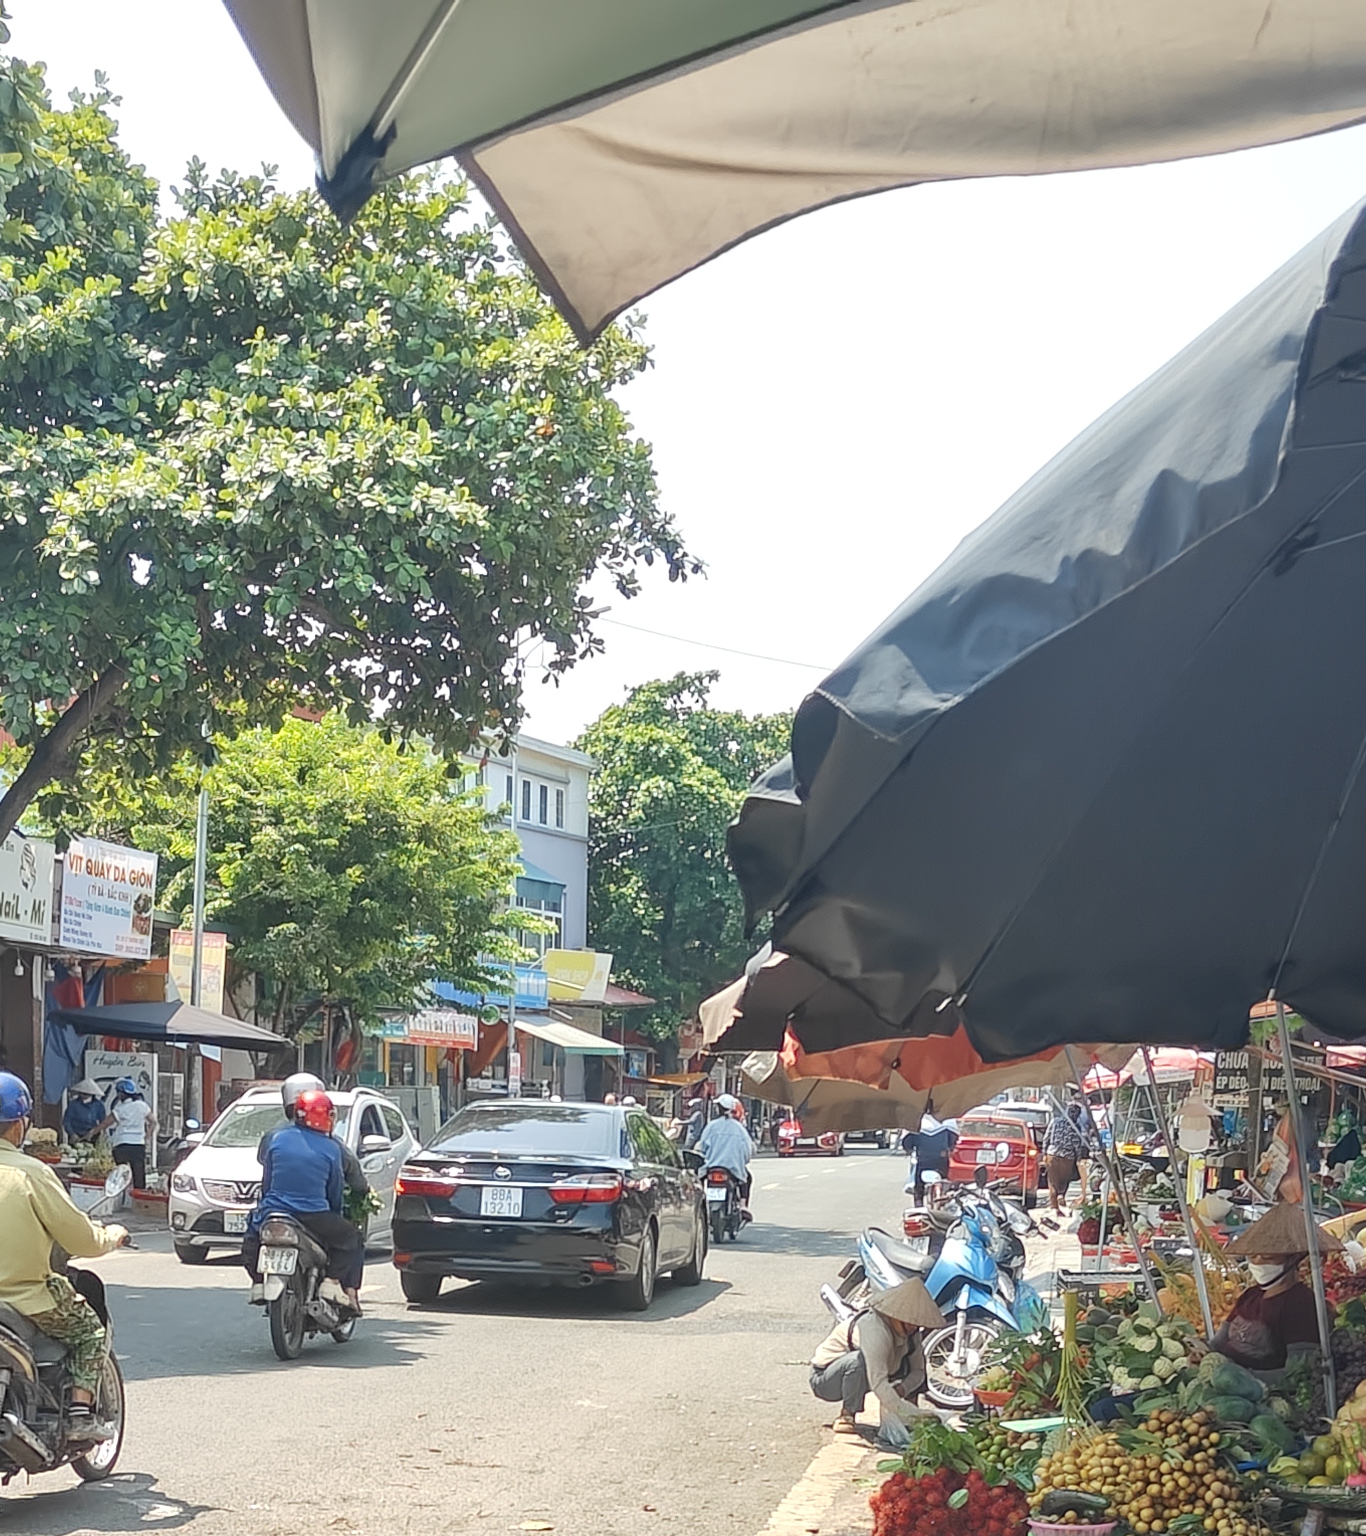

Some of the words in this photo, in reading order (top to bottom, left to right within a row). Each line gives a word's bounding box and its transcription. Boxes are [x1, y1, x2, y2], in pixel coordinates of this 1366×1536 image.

[69, 853, 84, 877] VỊT
[85, 858, 112, 880] QUAY
[114, 866, 127, 884] DA
[491, 1188, 513, 1201] 88A
[483, 1202, 520, 1215] 132.10
